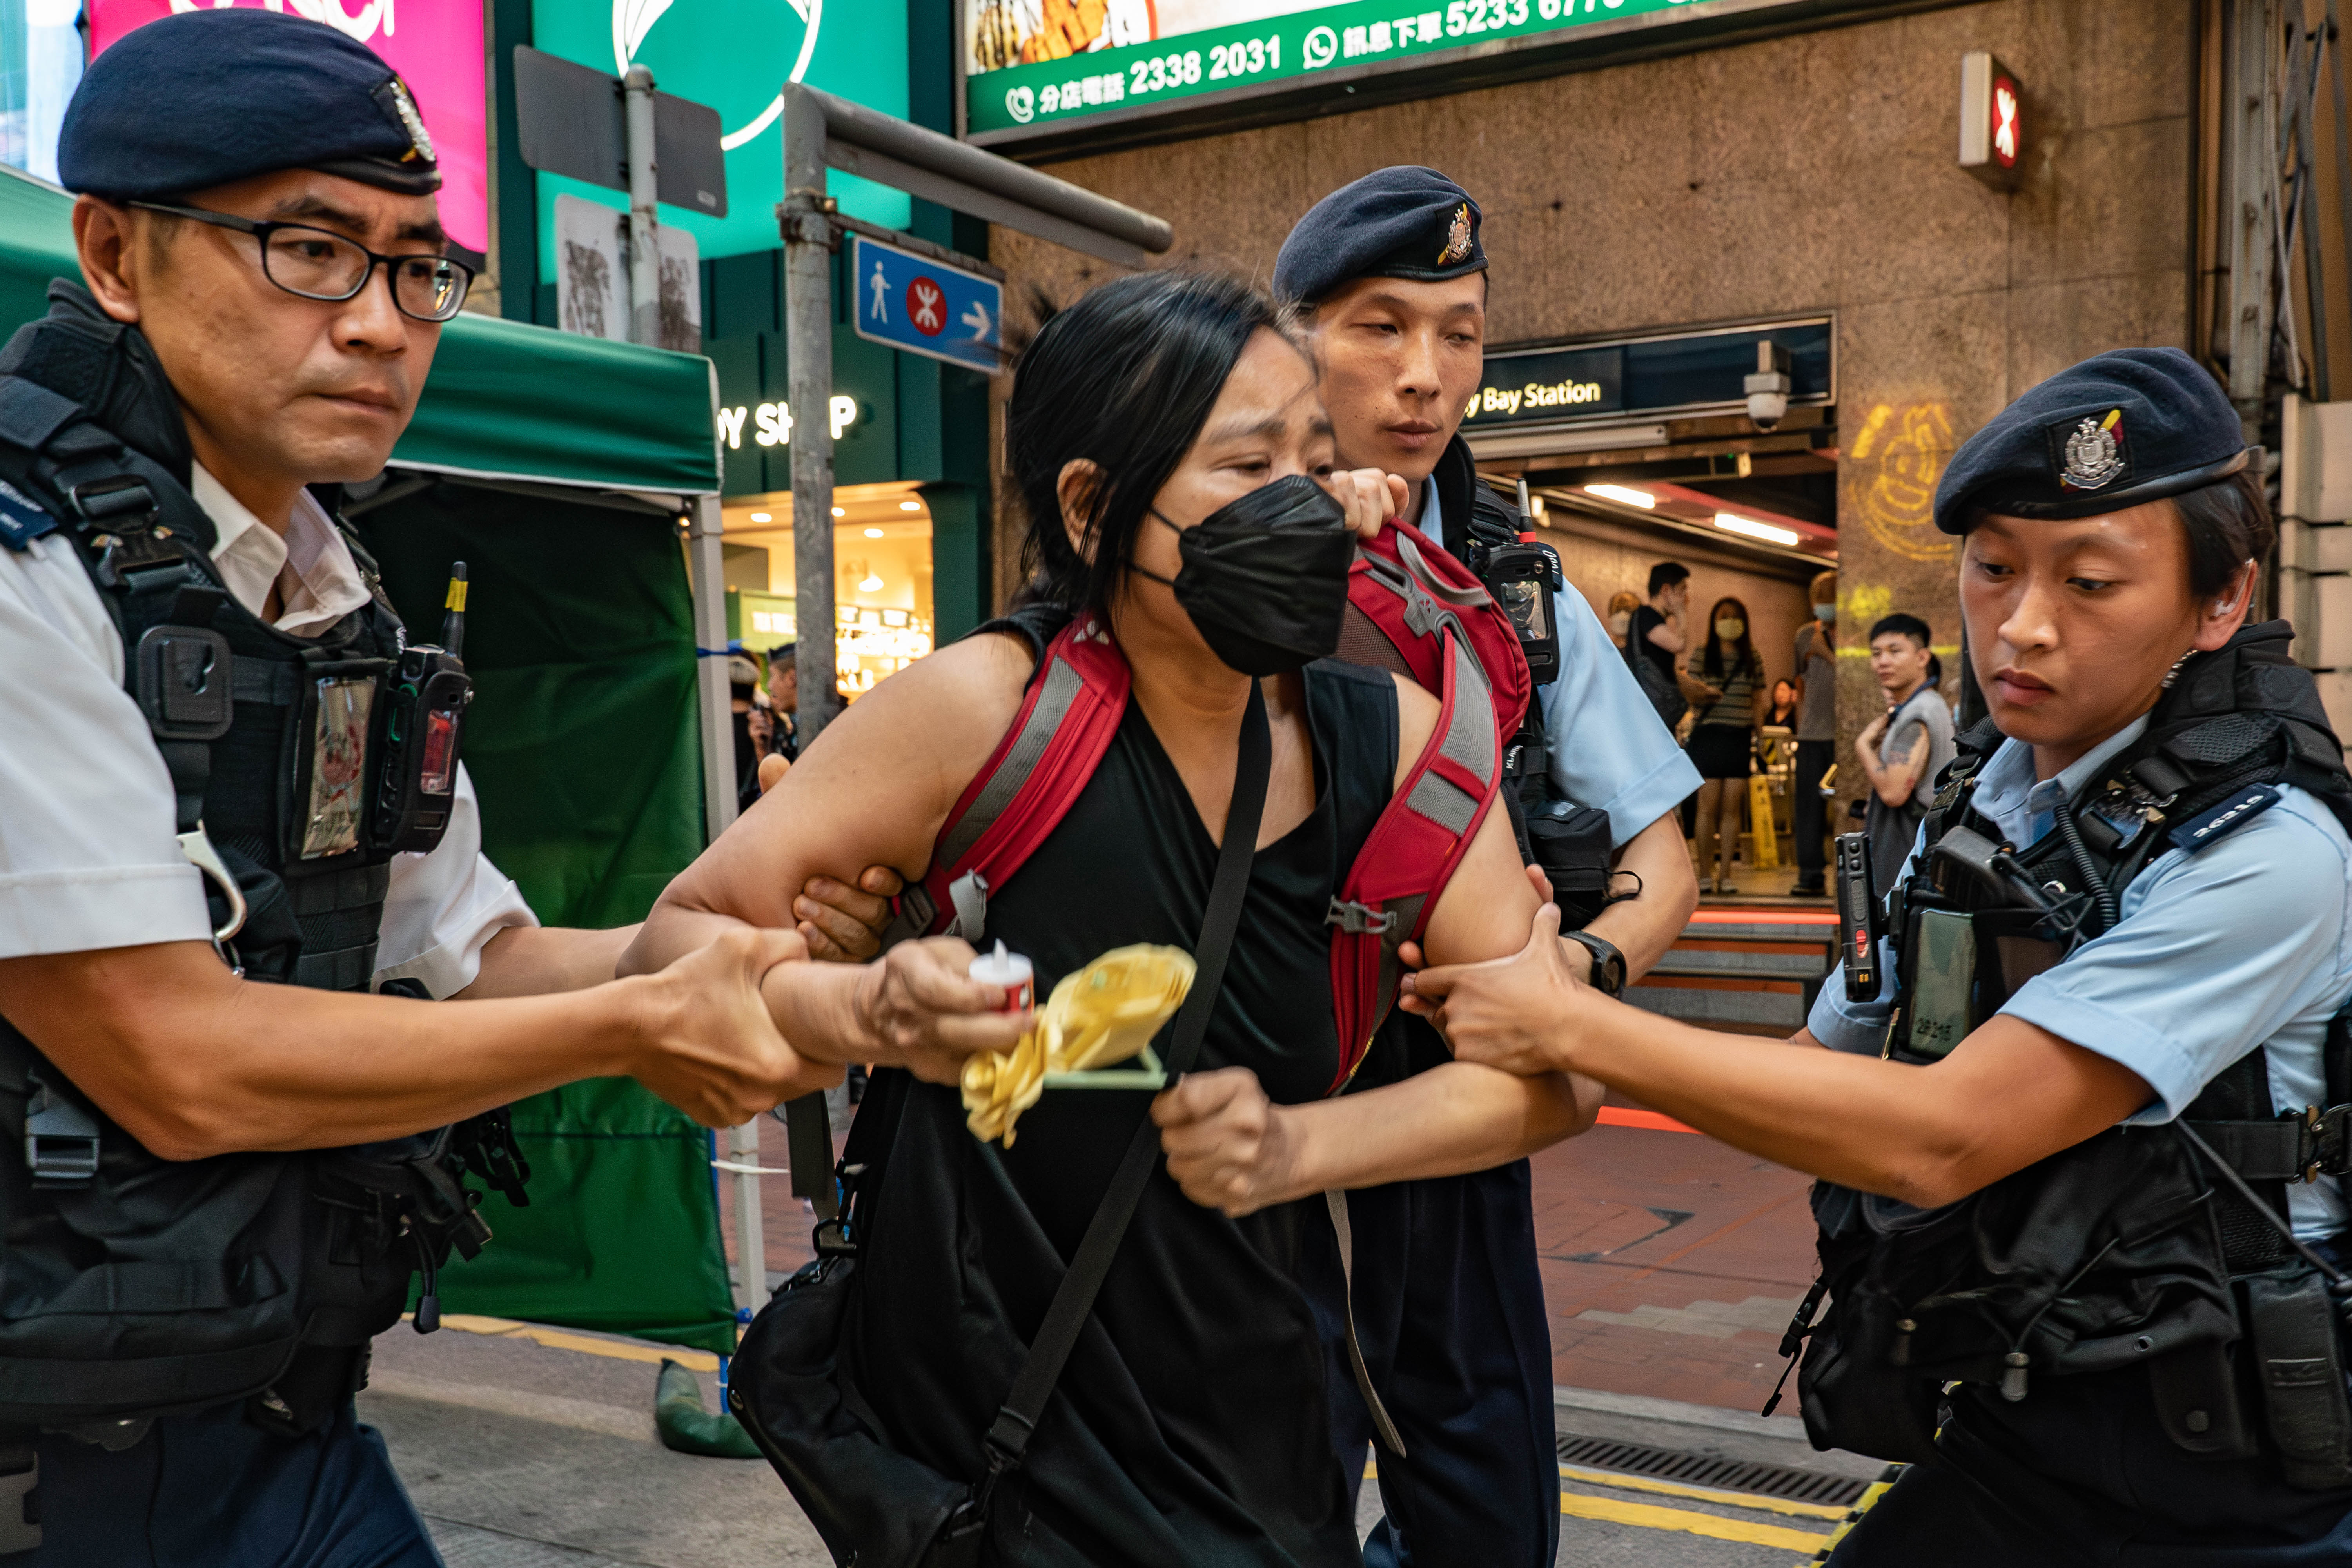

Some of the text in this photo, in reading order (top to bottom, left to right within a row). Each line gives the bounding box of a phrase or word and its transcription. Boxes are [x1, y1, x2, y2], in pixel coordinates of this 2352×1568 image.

[1039, 72, 1125, 114] 分店電話
[1130, 51, 1201, 94] 2338
[1209, 34, 1280, 80] 2031
[1446, 0, 1529, 37] 5233
[755, 396, 857, 446] SHP
[1465, 379, 1601, 418] y Bay Station
